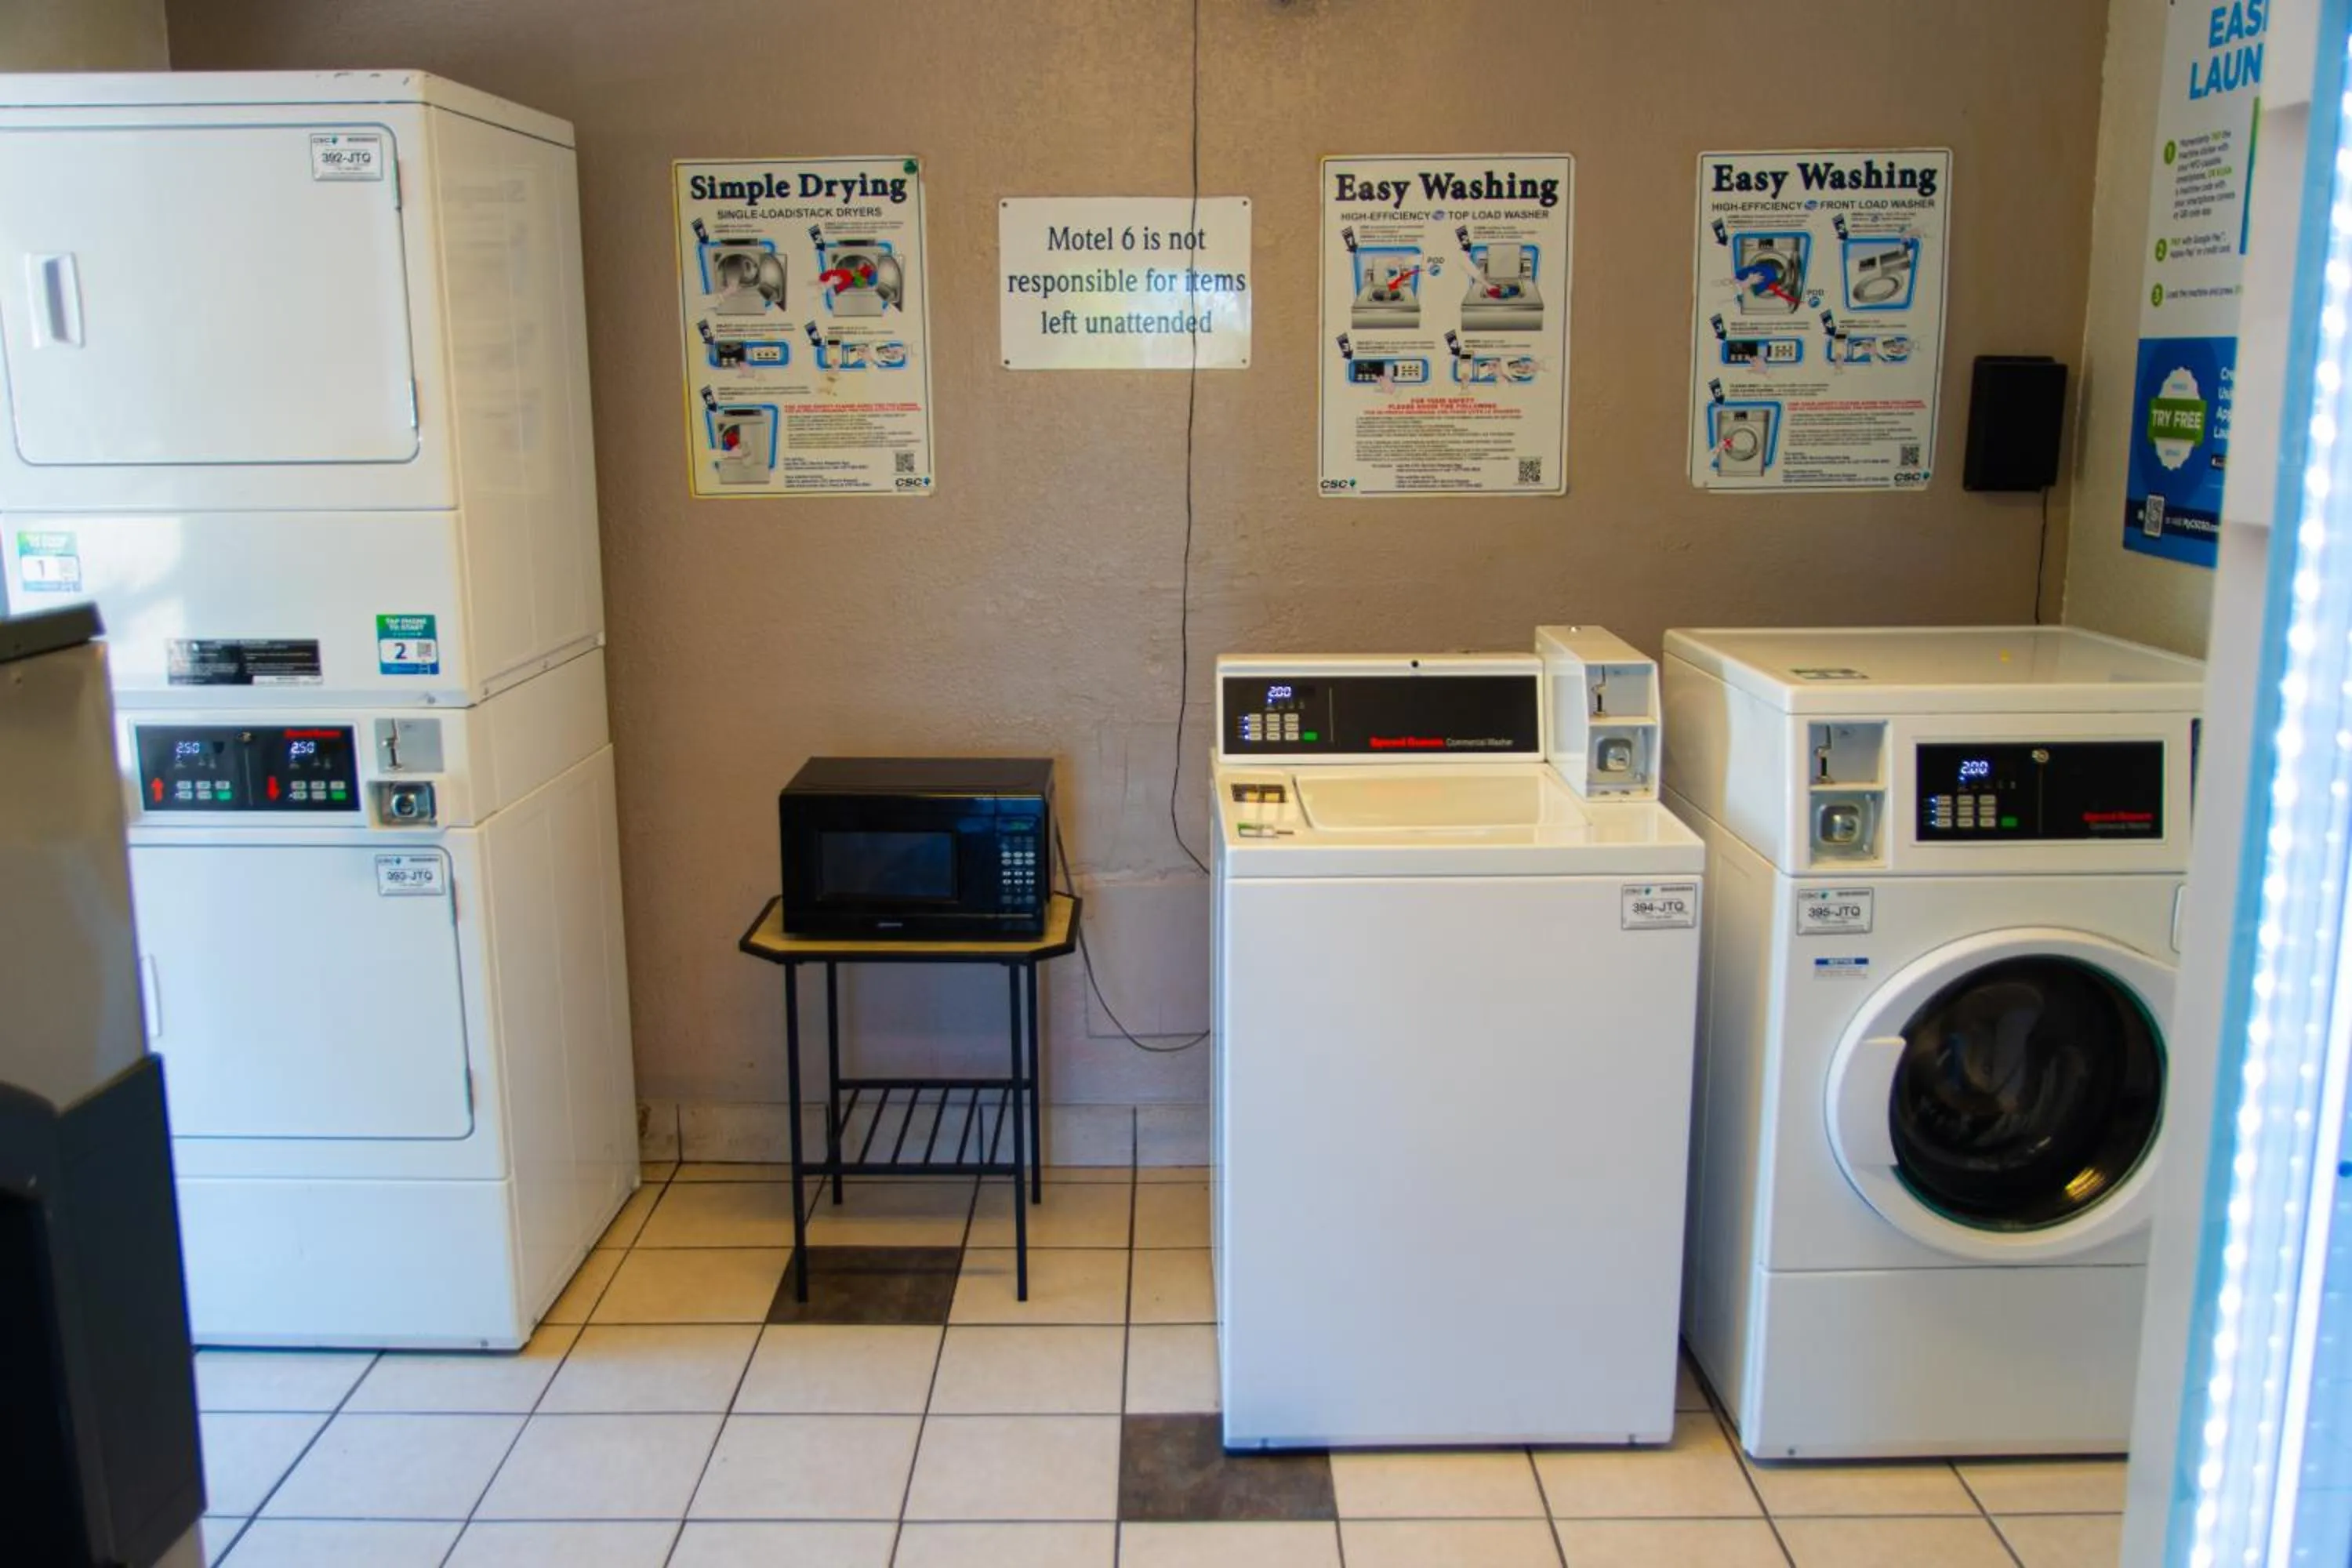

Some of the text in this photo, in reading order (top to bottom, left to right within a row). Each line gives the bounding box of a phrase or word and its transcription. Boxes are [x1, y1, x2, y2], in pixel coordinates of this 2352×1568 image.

[1711, 159, 1937, 200] Easy Washing
[690, 172, 907, 205] Simple Drying
[1334, 170, 1559, 209] Easy Washing
[1711, 201, 1802, 212] HIGH-EFFICIENCY
[1820, 198, 1935, 210] FRONT LOAD WASHER
[837, 206, 883, 217] DRYERS
[1341, 211, 1431, 221] HIGH-EFFICIENCY
[1448, 209, 1549, 220] TOP LOAD WASHER
[1047, 227, 1207, 251] Motel 6 is not
[1007, 268, 1246, 299] responsible for items
[1041, 310, 1212, 334] left unattended
[2151, 409, 2203, 430] TRY FREE
[895, 477, 922, 488] CSC
[1320, 479, 1348, 489] CSC
[1893, 471, 1921, 483] CSC
[394, 642, 407, 659] 2
